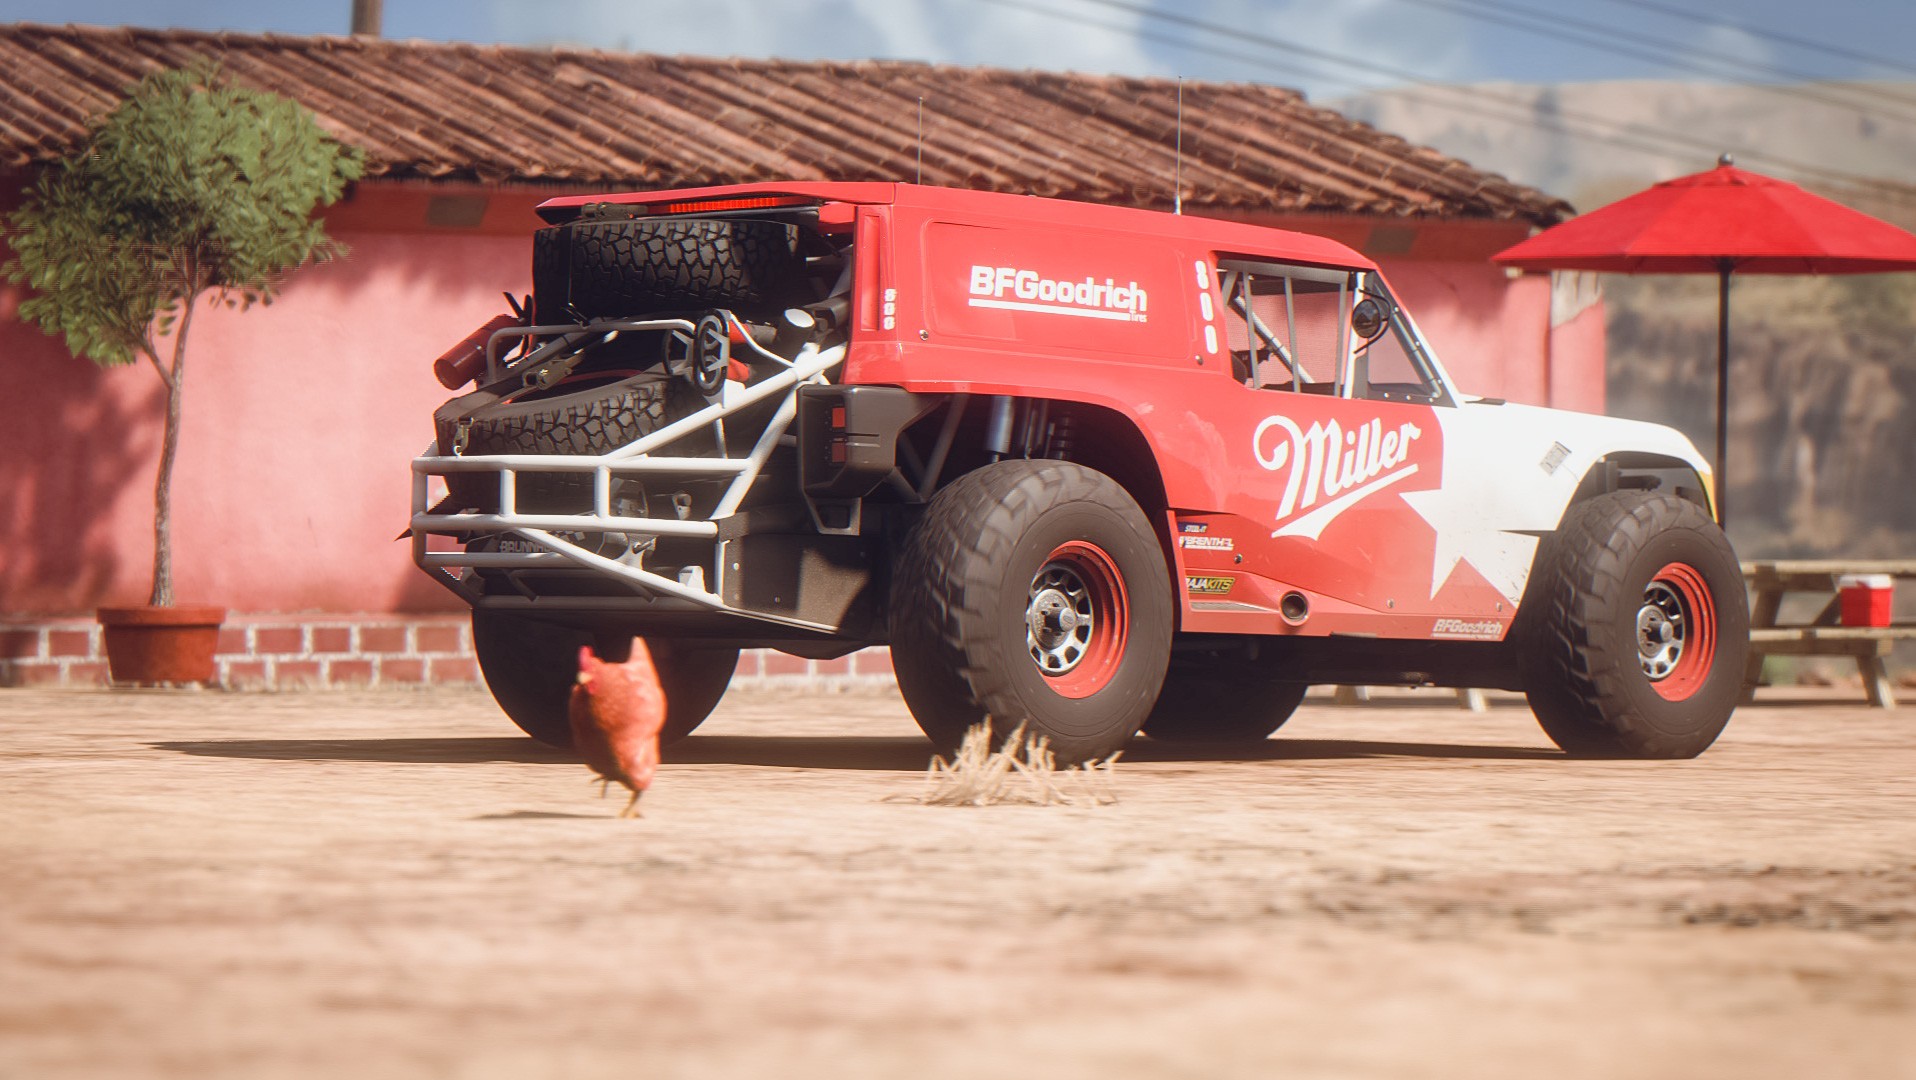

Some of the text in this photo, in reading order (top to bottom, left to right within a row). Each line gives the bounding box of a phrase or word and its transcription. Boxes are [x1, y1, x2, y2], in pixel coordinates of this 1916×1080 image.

[969, 265, 1147, 312] BFGoodrich
[1195, 260, 1218, 354] 800
[1253, 414, 1422, 521] Miller
